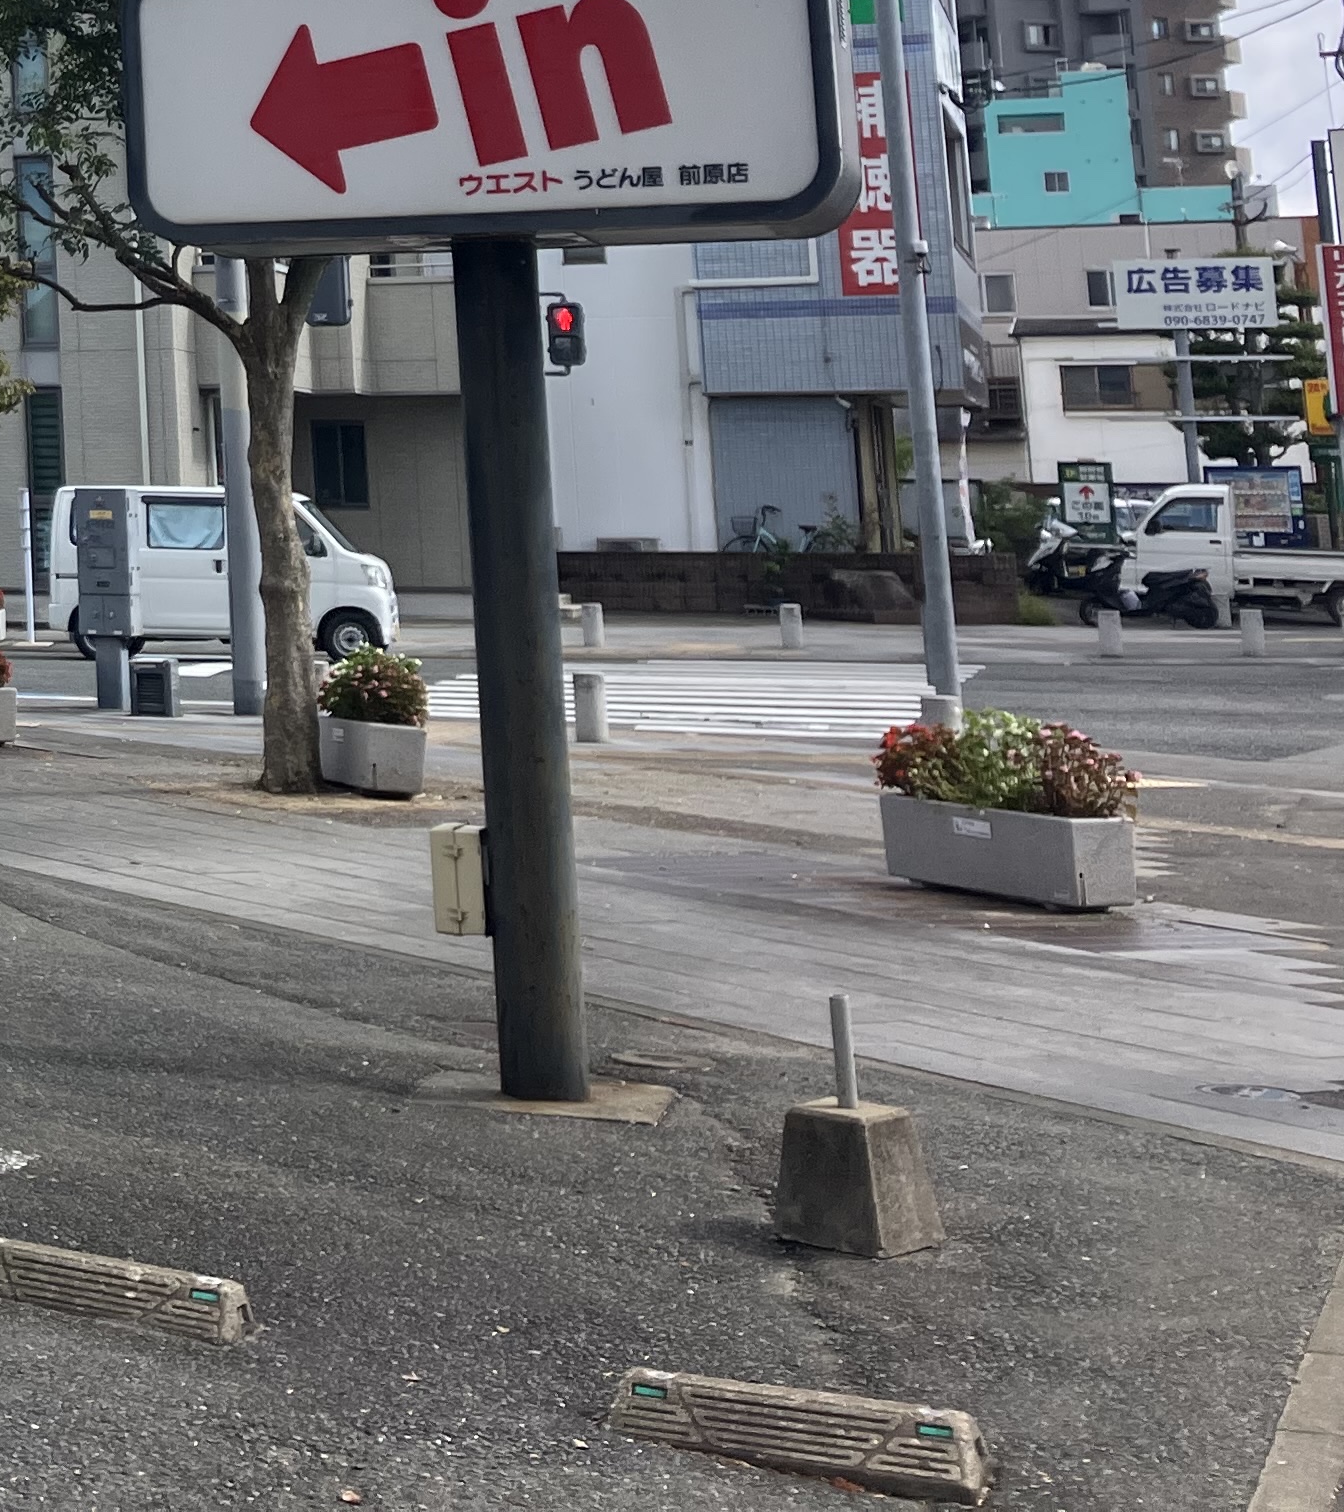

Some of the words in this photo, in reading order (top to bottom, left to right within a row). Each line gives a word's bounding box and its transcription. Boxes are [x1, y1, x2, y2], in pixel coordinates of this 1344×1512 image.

[459, 170, 563, 196] ウエスト
[573, 166, 664, 191] うどん屋
[678, 163, 750, 186] 前原店
[1127, 264, 1264, 294] 広告募集
